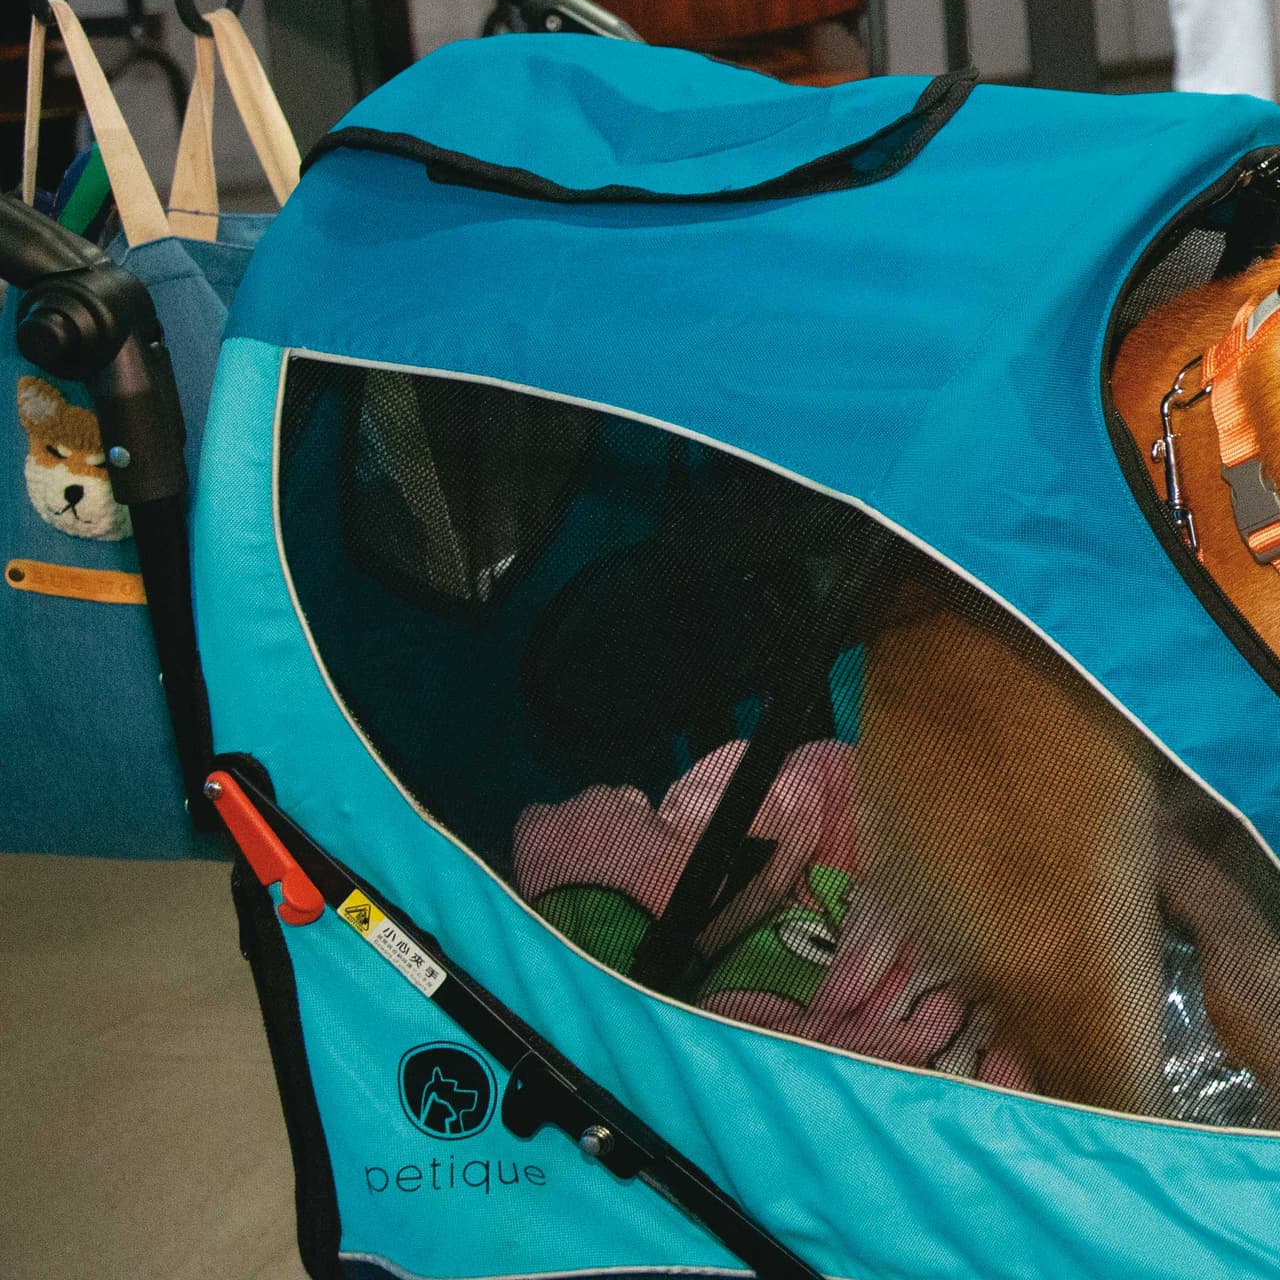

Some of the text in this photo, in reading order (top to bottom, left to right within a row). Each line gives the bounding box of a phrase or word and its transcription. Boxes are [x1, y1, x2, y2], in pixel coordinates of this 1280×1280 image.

[383, 927, 440, 980] 小心夾手
[365, 1155, 547, 1196] petique
